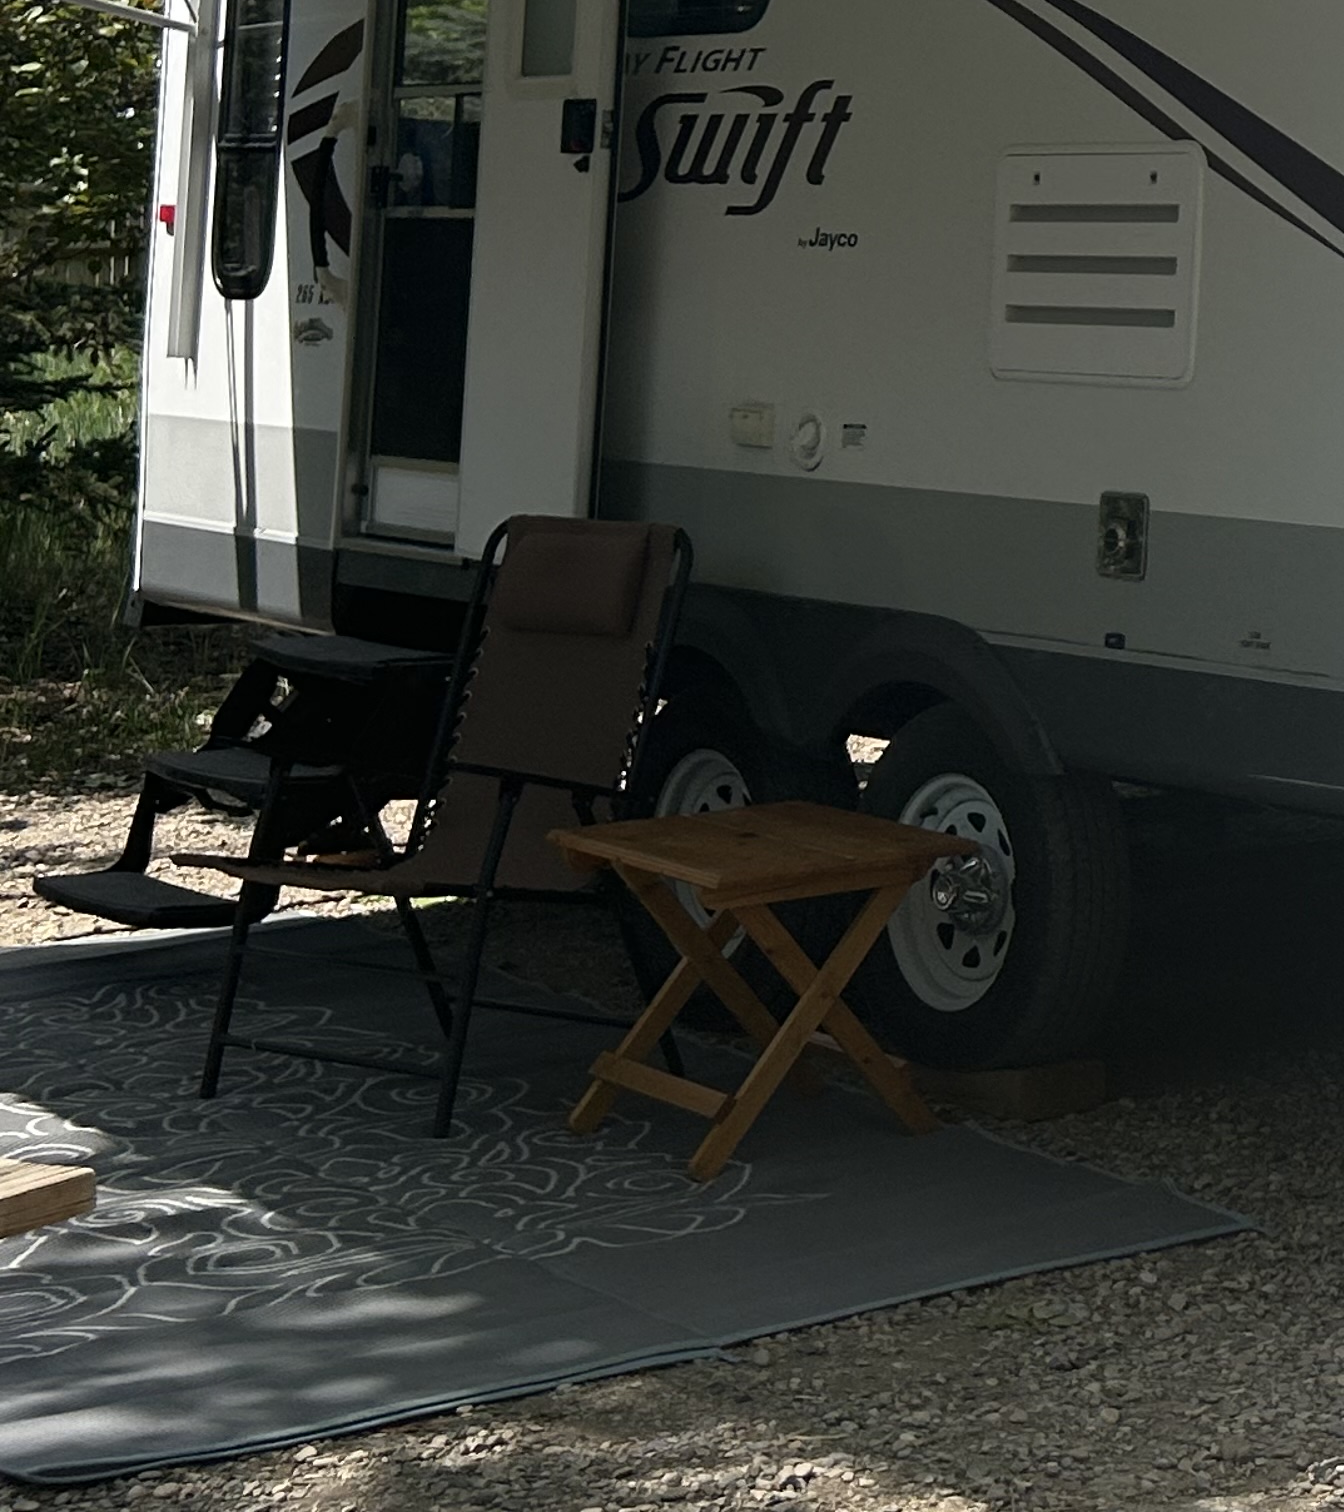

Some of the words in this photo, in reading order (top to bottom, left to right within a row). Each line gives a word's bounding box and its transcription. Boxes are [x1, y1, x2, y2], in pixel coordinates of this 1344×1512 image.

[654, 45, 768, 75] FLIGHT
[616, 79, 853, 216] Swift
[808, 226, 858, 252] Jayco
